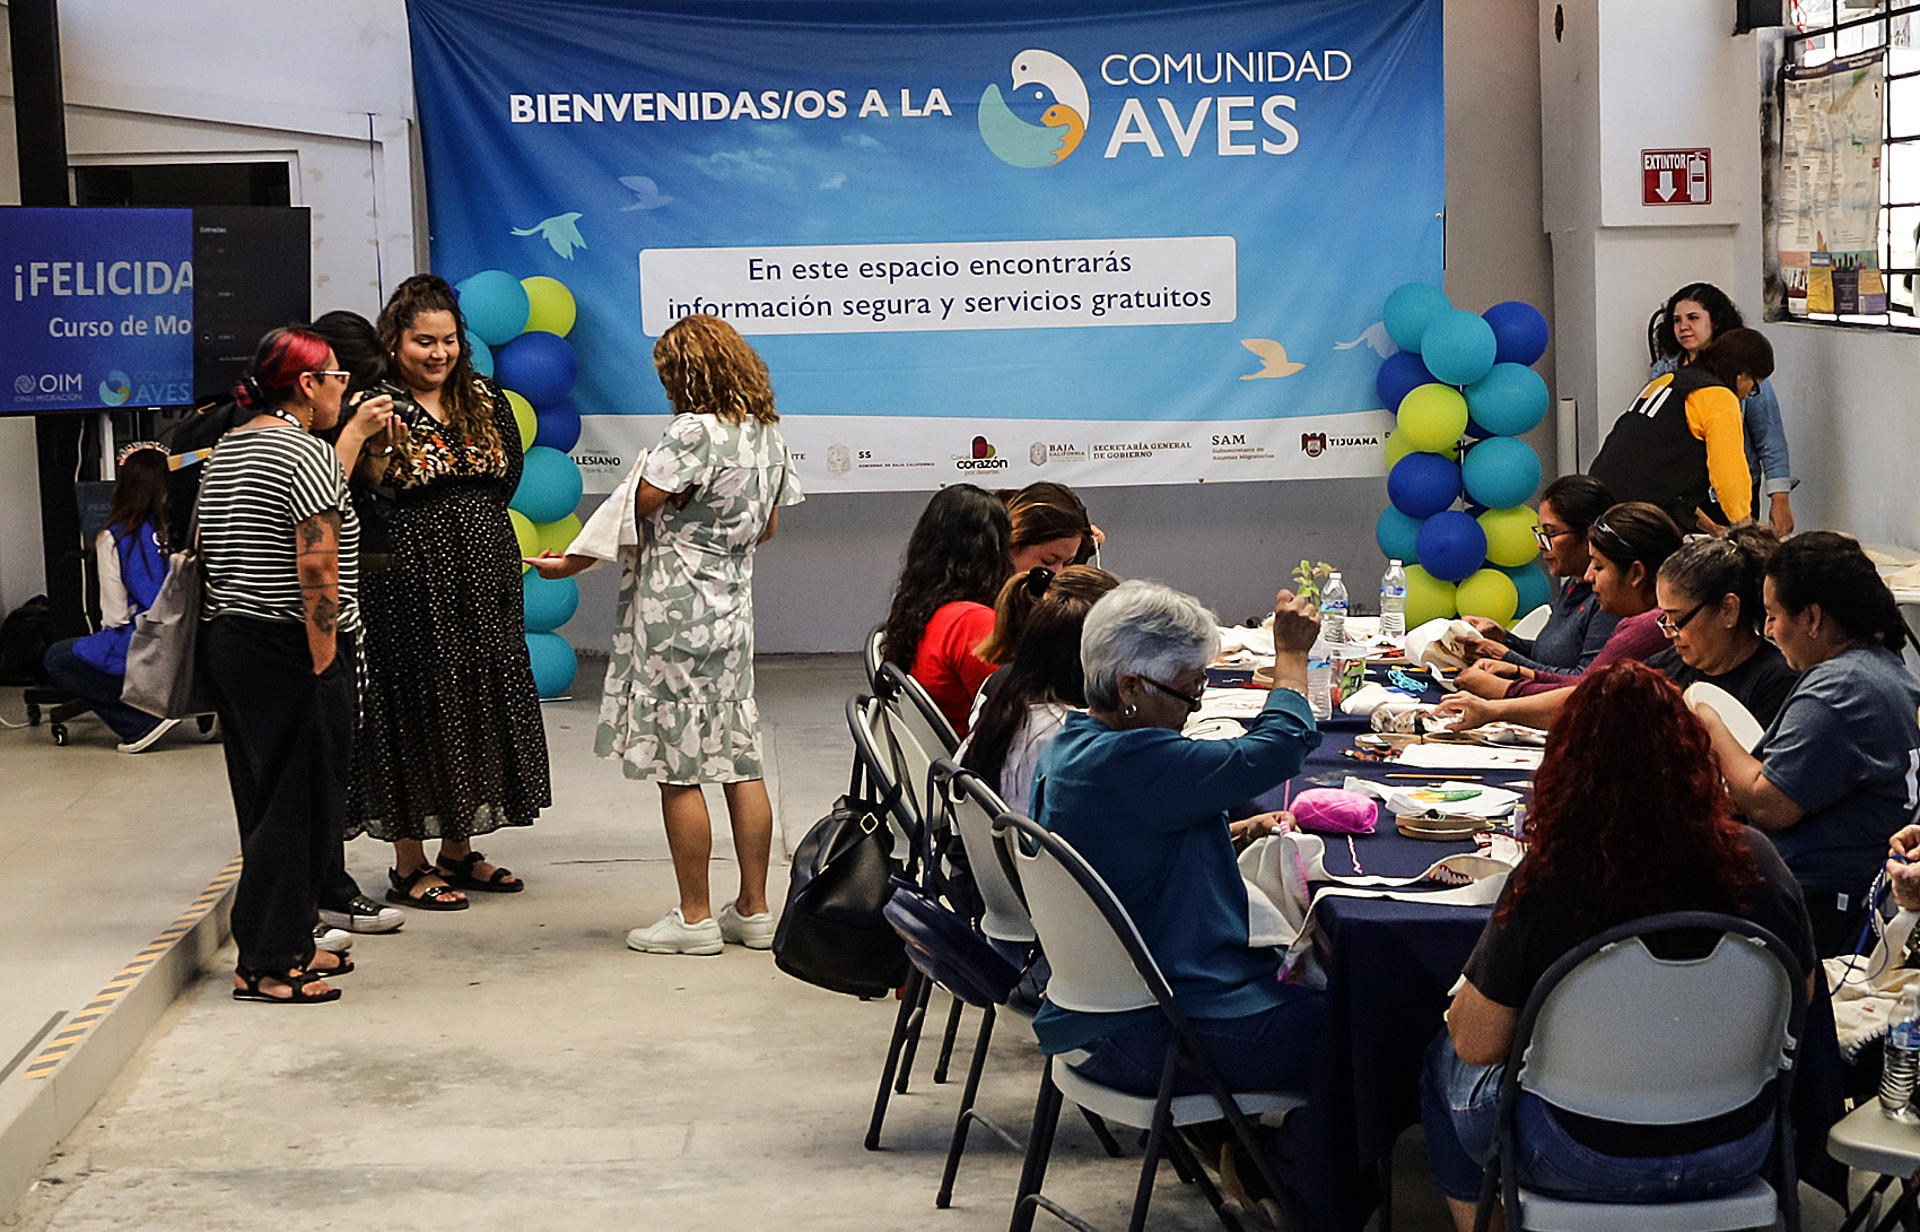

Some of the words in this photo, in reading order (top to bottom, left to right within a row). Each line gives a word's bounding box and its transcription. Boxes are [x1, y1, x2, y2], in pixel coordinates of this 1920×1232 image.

[1100, 50, 1352, 86] COMUNIDAD
[509, 90, 847, 123] BIENVENIDAS/OS
[857, 89, 889, 118] A
[901, 88, 952, 117] LA
[1103, 95, 1299, 158] AVES
[1644, 153, 1687, 170] EXTINTOR
[749, 257, 781, 281] En
[791, 260, 849, 280] este
[858, 255, 960, 285] espacio
[968, 250, 1132, 276] encontrarás
[14, 261, 193, 301] ¡FELICIDA
[668, 294, 832, 320] información
[842, 297, 931, 322] segura
[940, 296, 955, 321] y
[964, 290, 1082, 314] servicios
[1090, 286, 1212, 317] gratuitos
[49, 316, 113, 337] Curso
[120, 315, 147, 336] de
[155, 315, 192, 336] Mo
[39, 373, 83, 394] OIM
[134, 382, 191, 403] AVES
[1093, 442, 1149, 451] SECRETARÍA
[1150, 441, 1192, 450] GENERAL
[1212, 435, 1246, 445] SAM
[1328, 437, 1378, 447] TIJUANA
[570, 456, 621, 467] LESIANO
[858, 450, 872, 459] SS
[956, 456, 1008, 470] corazón
[1107, 451, 1153, 459] GOBIERNO
